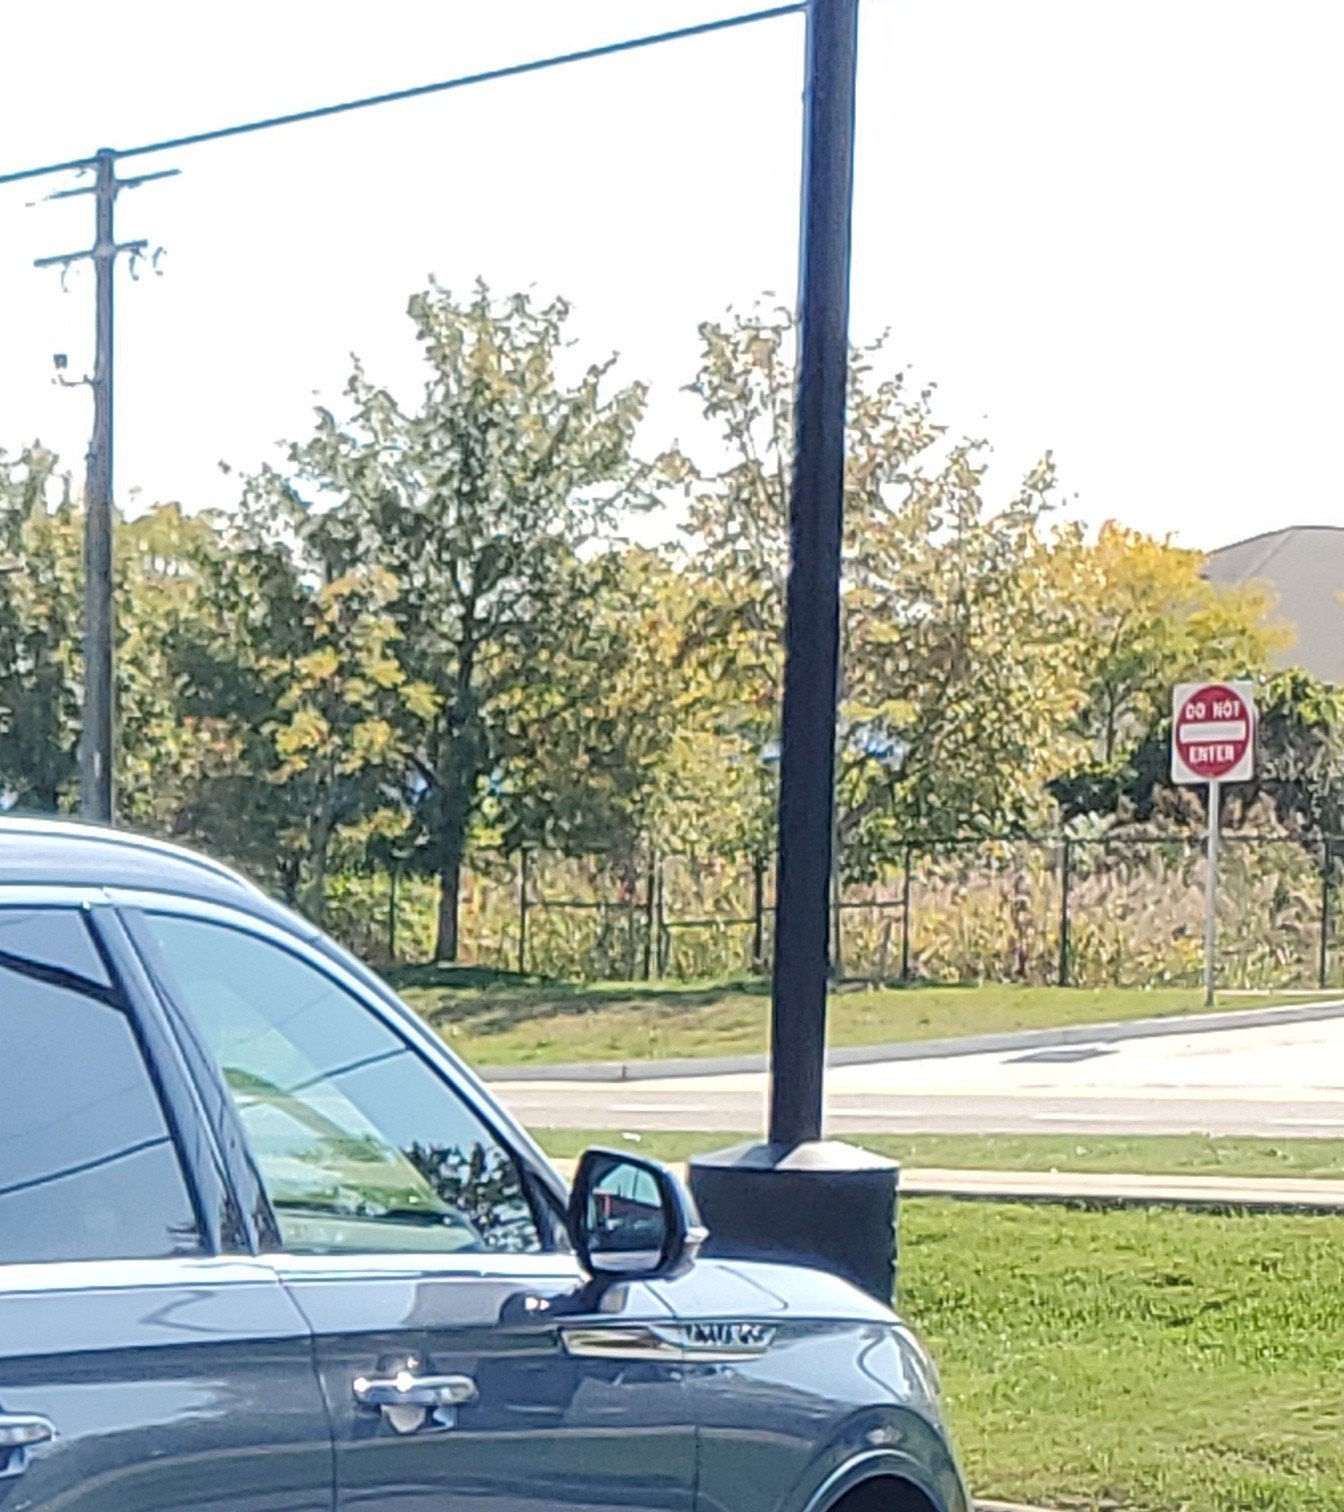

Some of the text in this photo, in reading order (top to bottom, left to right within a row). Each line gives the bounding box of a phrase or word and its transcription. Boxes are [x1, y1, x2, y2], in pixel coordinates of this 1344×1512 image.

[1185, 700, 1240, 719] DO NOT
[1189, 745, 1234, 763] ENTER
